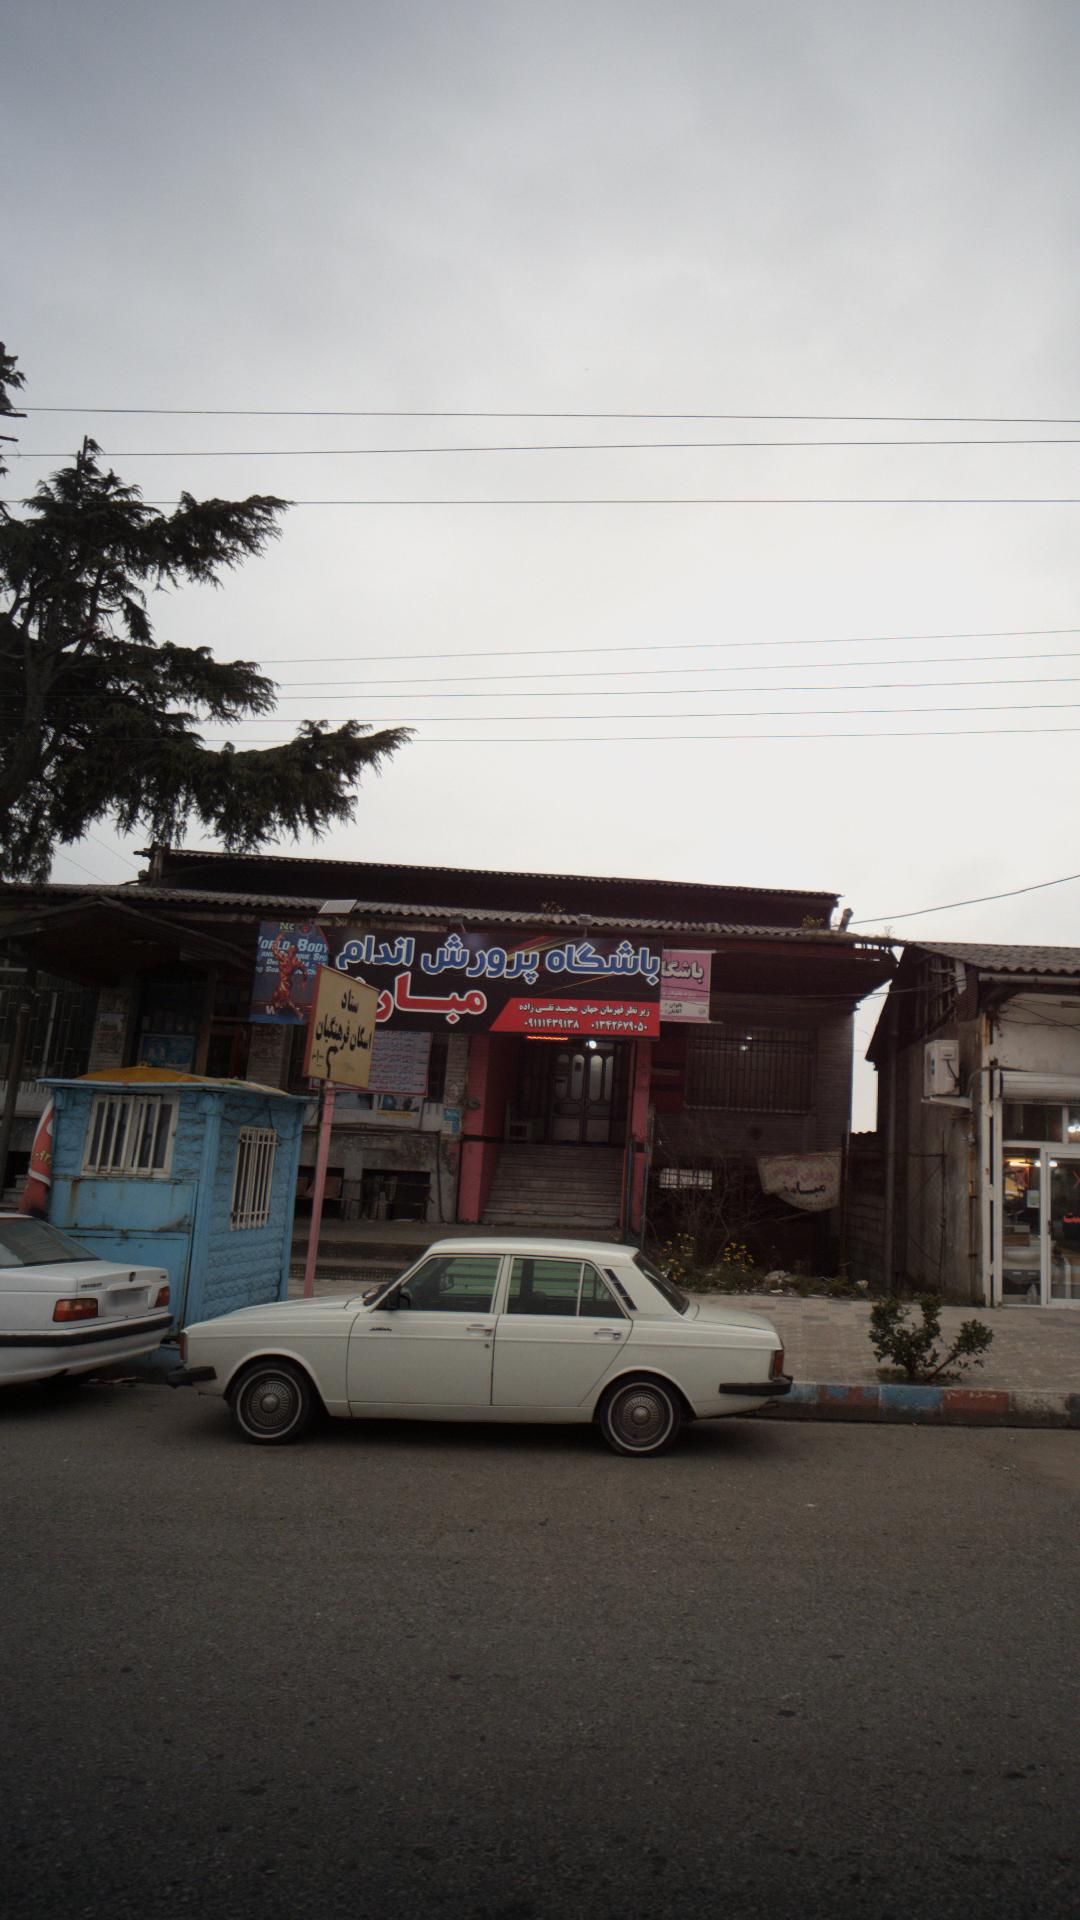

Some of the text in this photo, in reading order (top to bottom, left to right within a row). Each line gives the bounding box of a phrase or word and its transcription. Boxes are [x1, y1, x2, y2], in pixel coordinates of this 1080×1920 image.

[335, 933, 661, 986] باشگاه پرورش اندام
[661, 960, 704, 984] باشگا
[341, 989, 359, 1014] ستاد
[356, 971, 487, 1024] مبار
[581, 1004, 599, 1015] جهان
[600, 1004, 624, 1016] قهرمان
[625, 1005, 638, 1016] نظر
[639, 1006, 650, 1017] زیر
[315, 1014, 350, 1050] فرهنگیان
